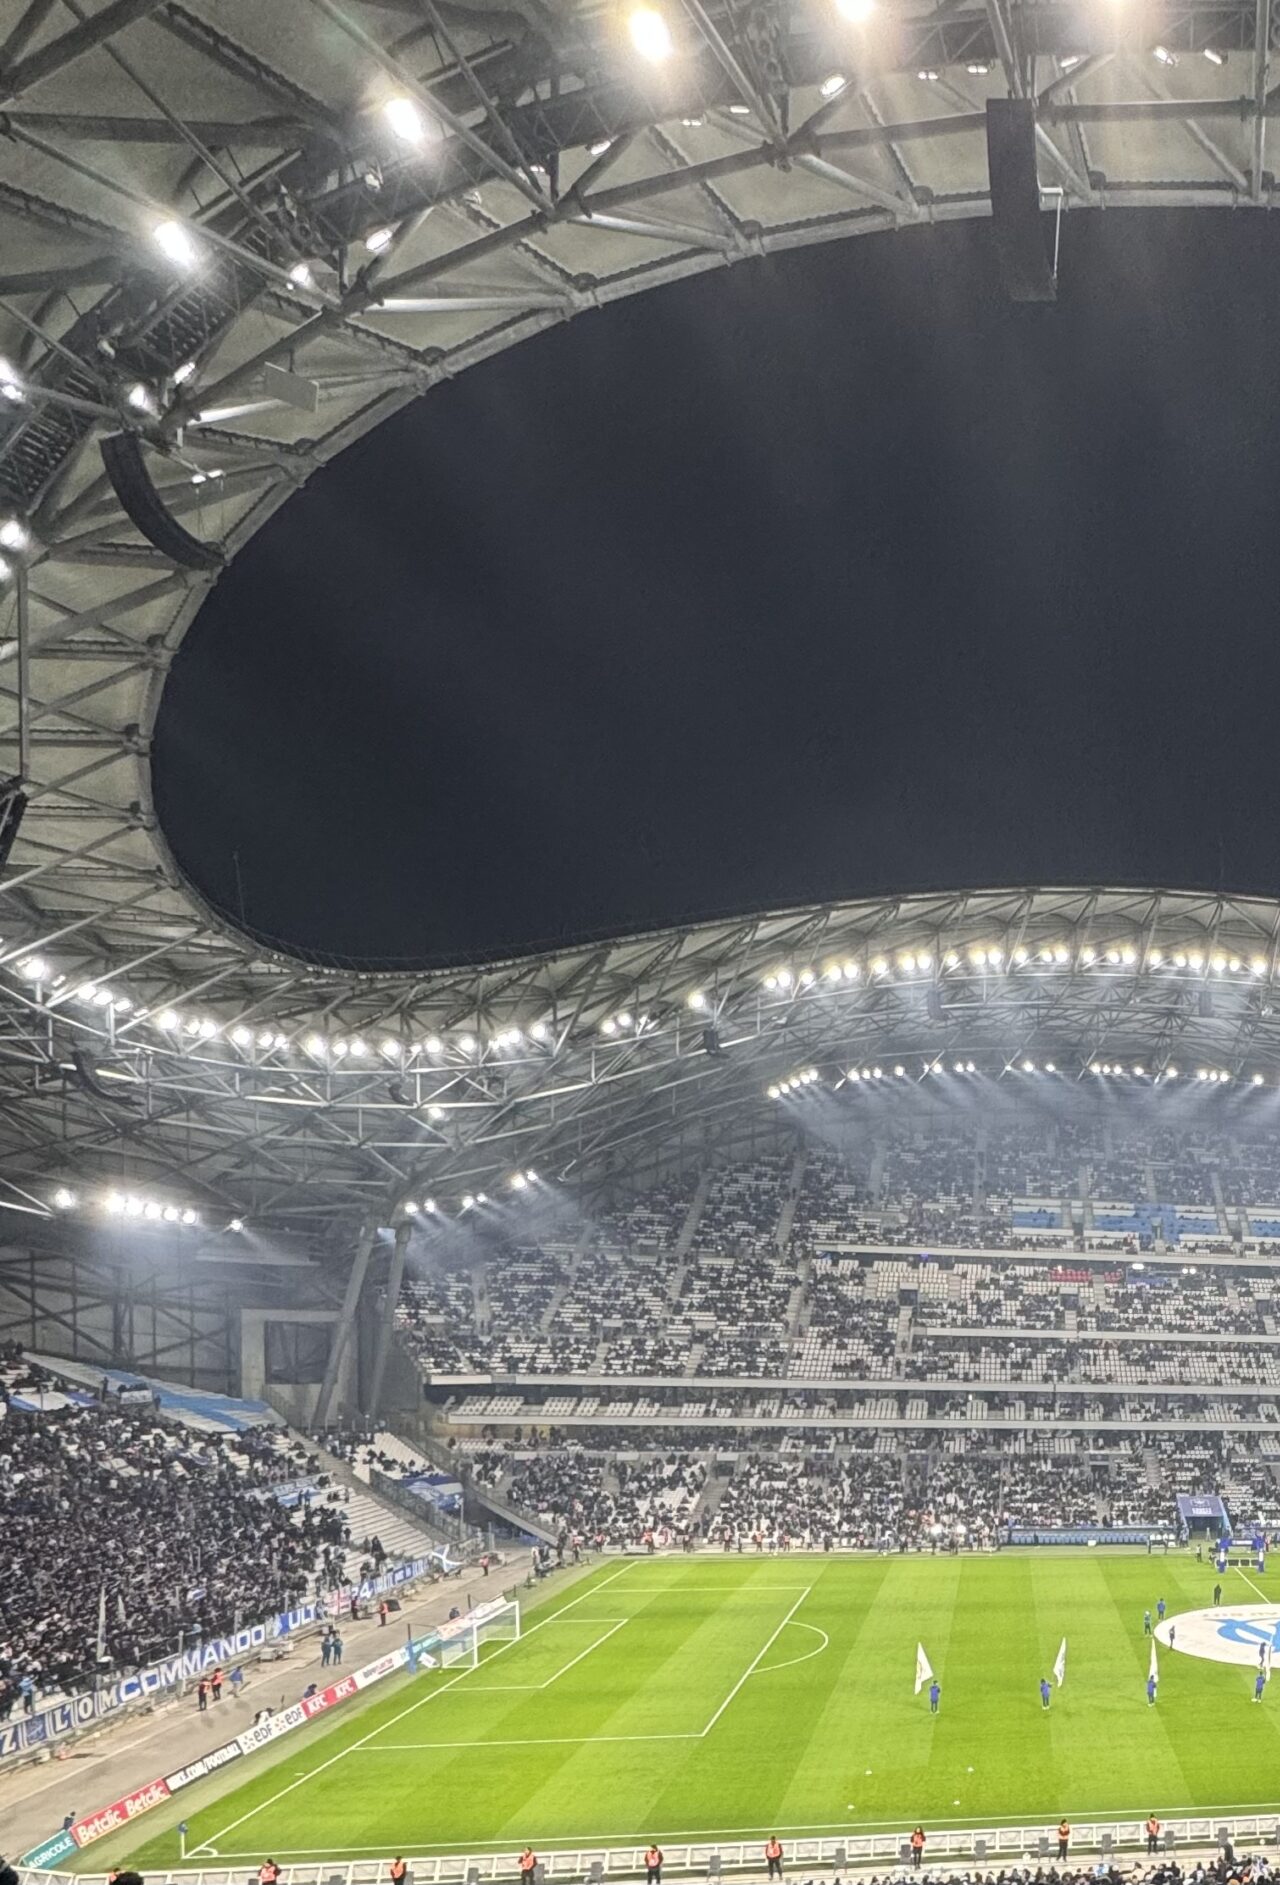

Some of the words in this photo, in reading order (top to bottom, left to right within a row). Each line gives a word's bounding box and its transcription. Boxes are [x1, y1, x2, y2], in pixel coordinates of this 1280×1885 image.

[119, 1624, 266, 1702] COMMANDO
[309, 1693, 328, 1714] KFC
[334, 1679, 355, 1699] KFC
[53, 1684, 119, 1732] L'OM
[124, 1784, 167, 1817] Betclic
[77, 1809, 123, 1843] Betclic
[28, 1836, 75, 1869] AGRICOLE
